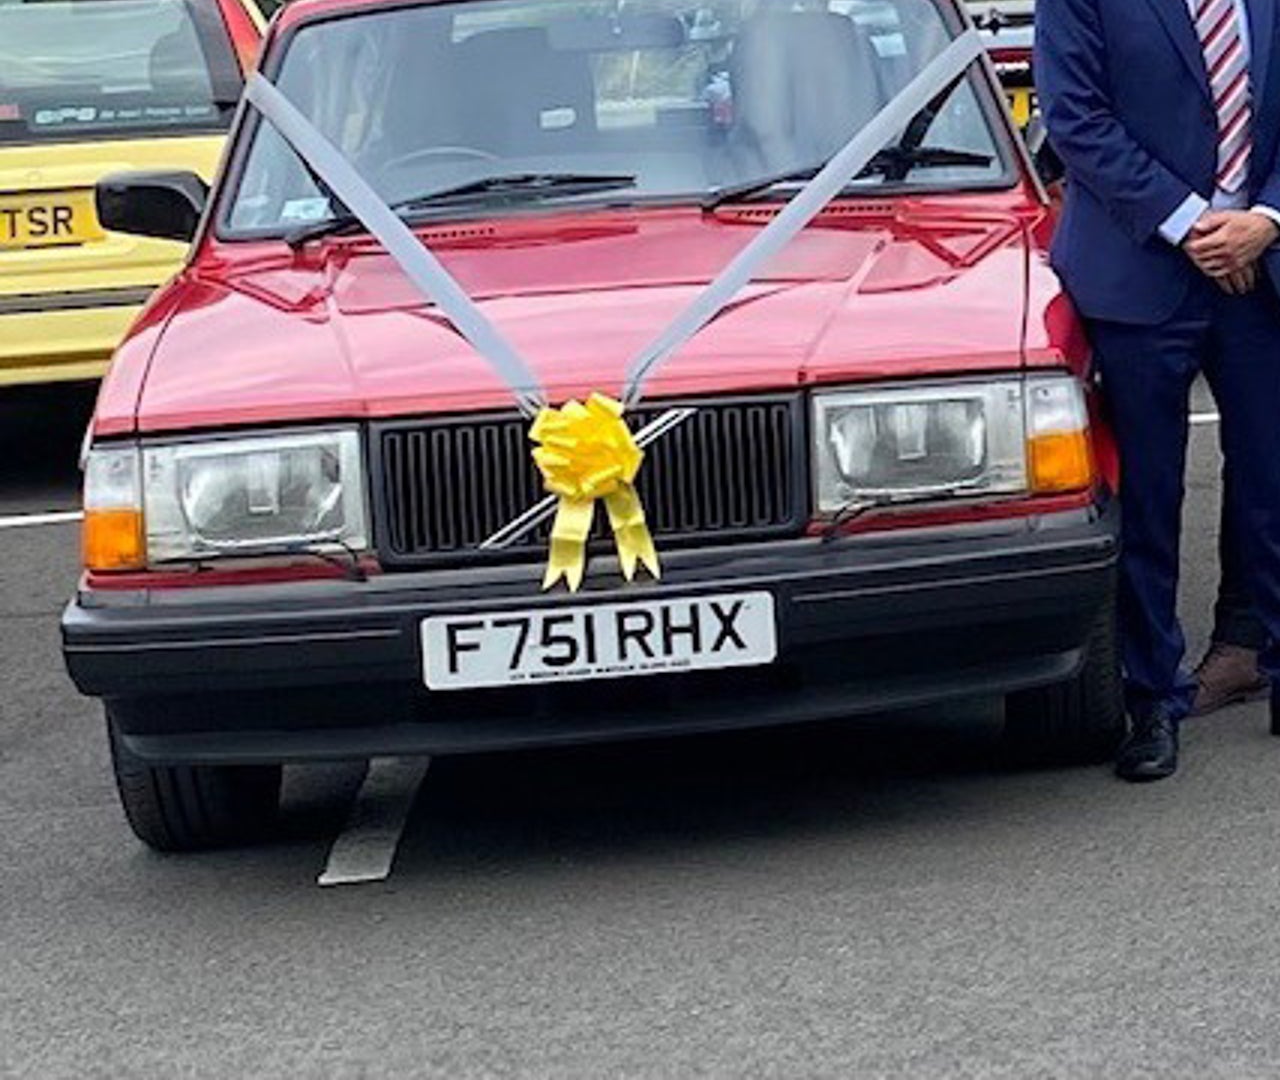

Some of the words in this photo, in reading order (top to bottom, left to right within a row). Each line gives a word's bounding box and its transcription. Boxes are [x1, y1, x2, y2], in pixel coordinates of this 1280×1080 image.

[1, 206, 74, 237] TSR
[446, 613, 598, 674] F751
[615, 601, 746, 661] RHX
